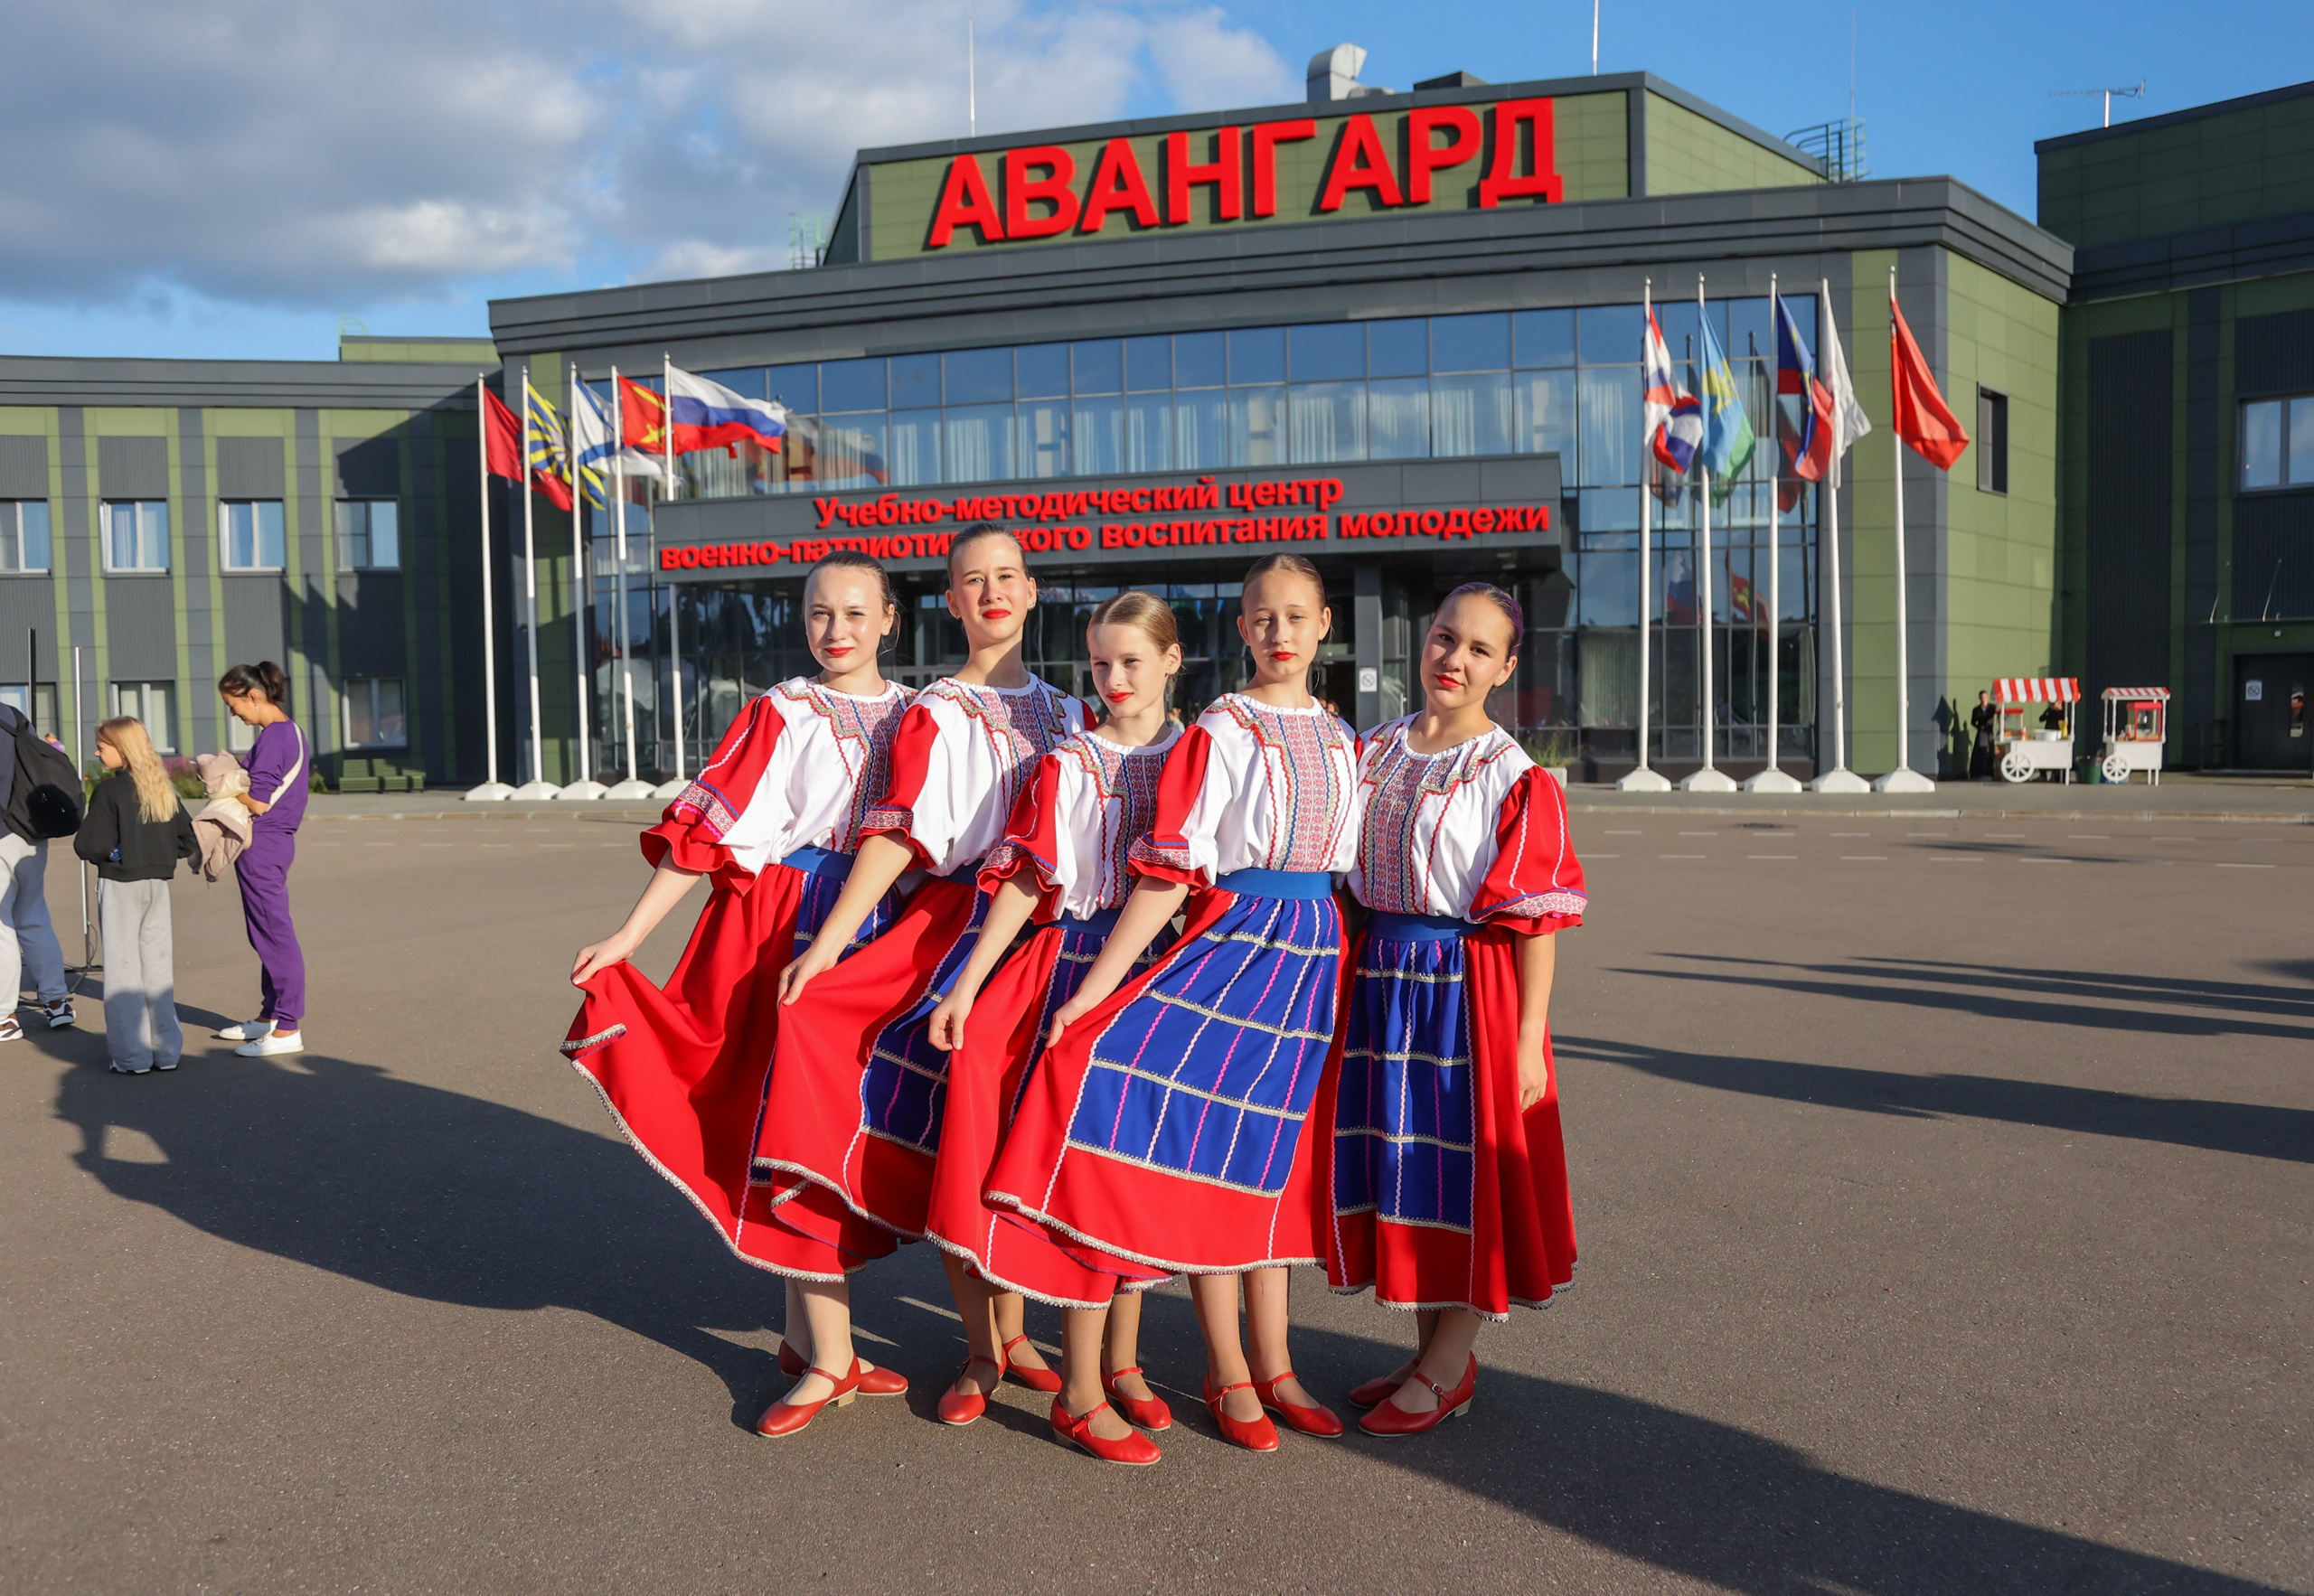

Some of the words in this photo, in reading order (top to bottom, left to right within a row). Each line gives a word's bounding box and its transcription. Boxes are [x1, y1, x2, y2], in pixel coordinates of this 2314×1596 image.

[929, 97, 1564, 247] АВАНГАРД
[815, 475, 1219, 528] Учебно-методический
[1229, 477, 1344, 512] центр
[661, 524, 1093, 569] военно-патриотикого
[1102, 513, 1330, 549] воспитания
[1340, 505, 1550, 538] молодежи
